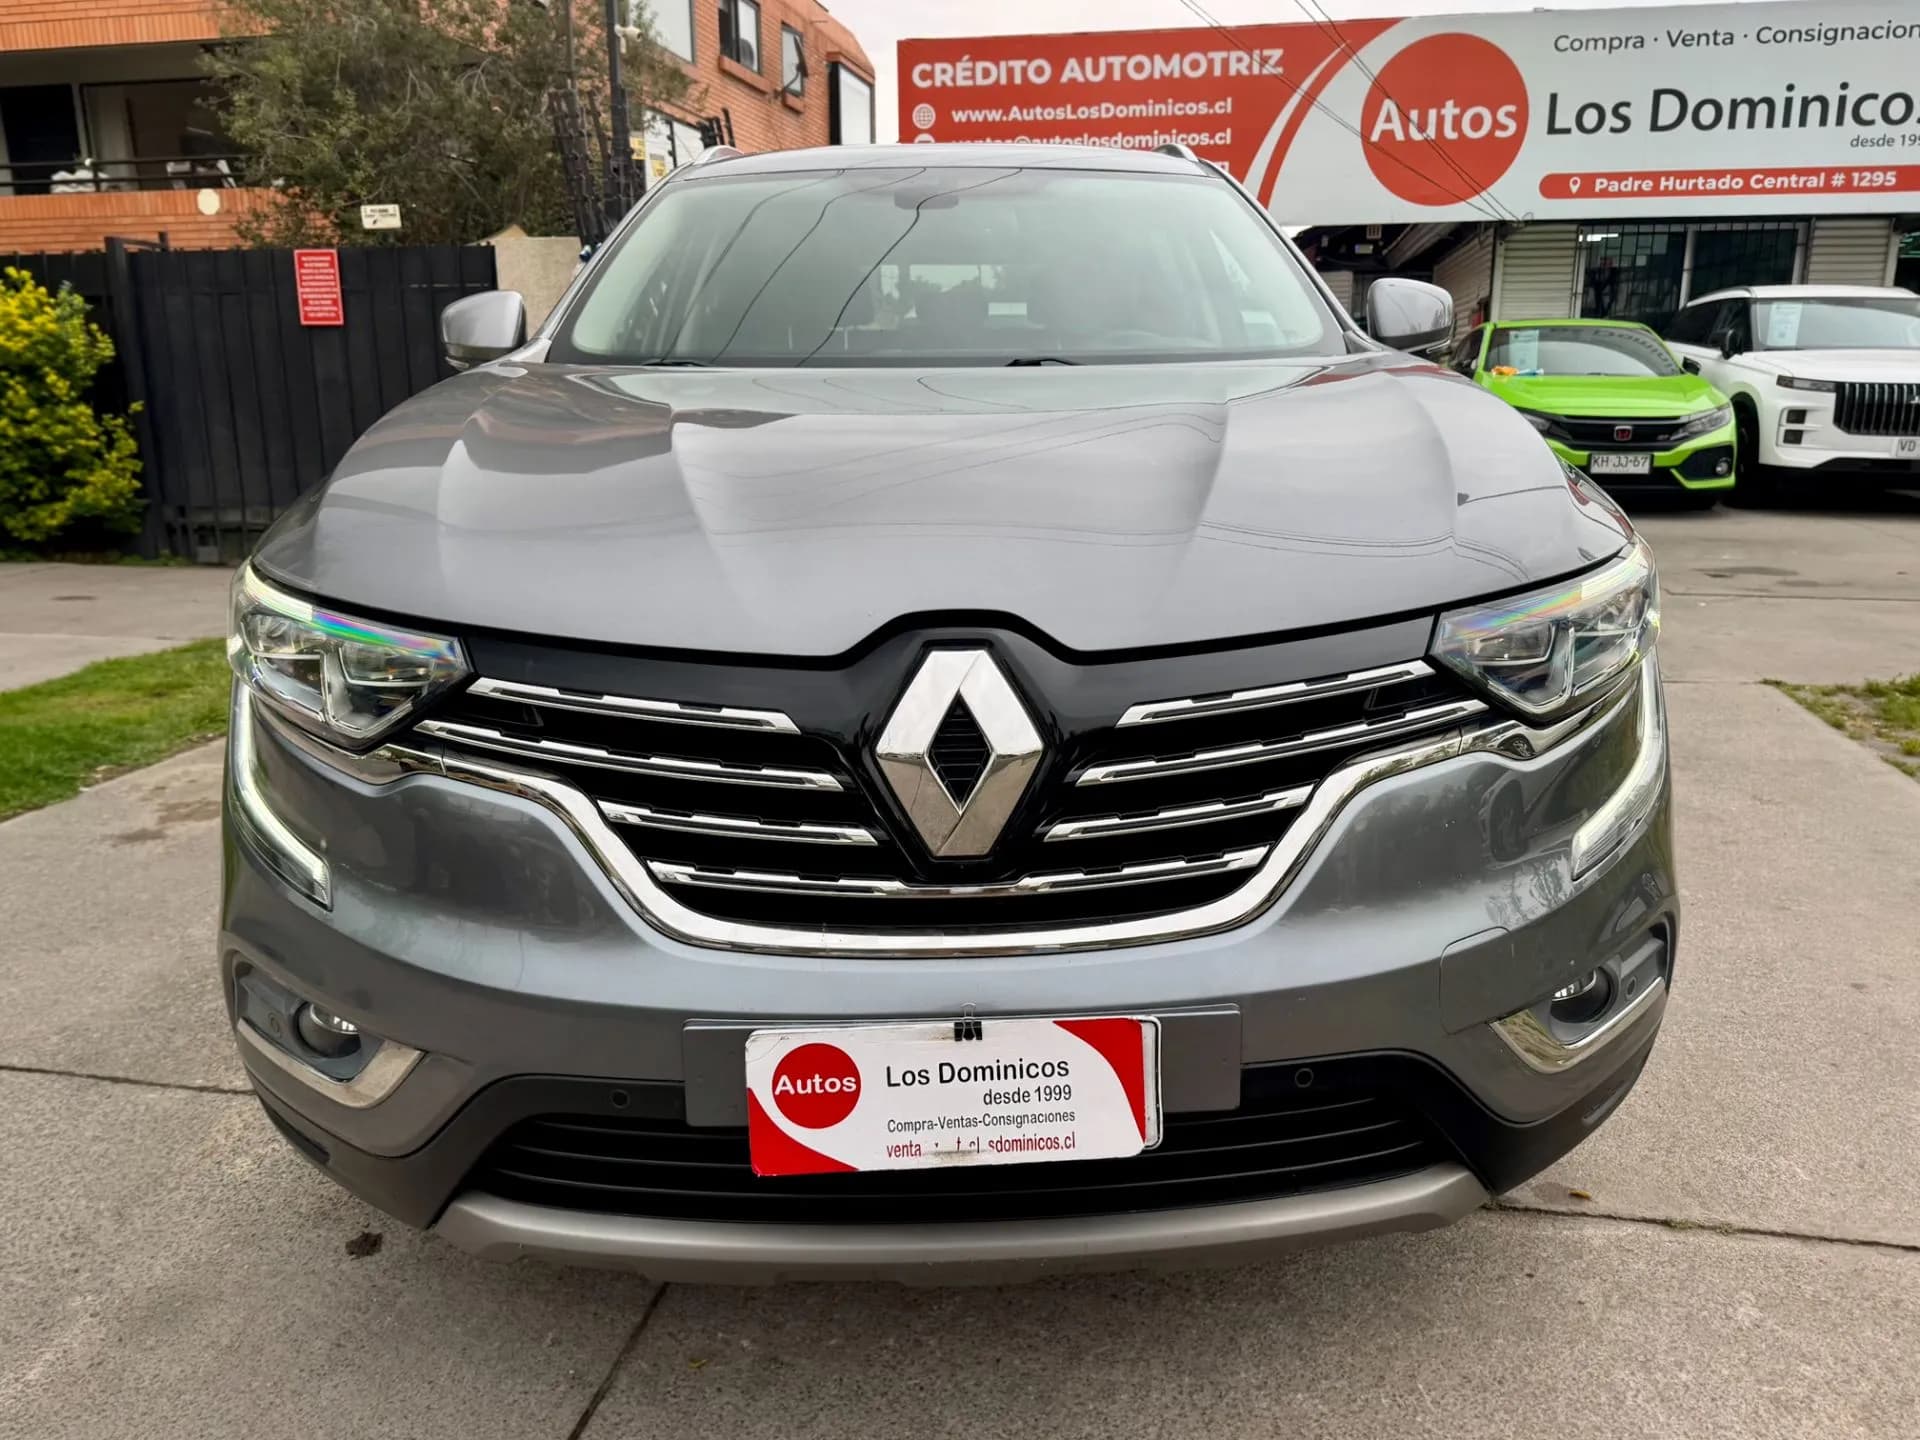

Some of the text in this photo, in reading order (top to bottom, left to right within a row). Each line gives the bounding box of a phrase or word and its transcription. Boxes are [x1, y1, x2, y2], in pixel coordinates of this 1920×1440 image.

[1554, 35, 1645, 54] Compra
[1666, 30, 1735, 48] Venta
[912, 48, 1284, 89] CRÉDITO AUTOMOTRIZ
[951, 98, 1233, 123] www.AutosLosDominicos.cl
[1370, 99, 1518, 142] Autos
[1546, 92, 1632, 135] Los
[1850, 134, 1895, 148] desde
[1594, 171, 1897, 193] Padre Hurtado Central # 1295
[774, 1073, 857, 1096] Autos
[886, 1058, 1070, 1087] Los Dominicos
[983, 1084, 1072, 1105] desde 1999
[887, 1110, 1076, 1134] Compra-Ventas-Consignaciones
